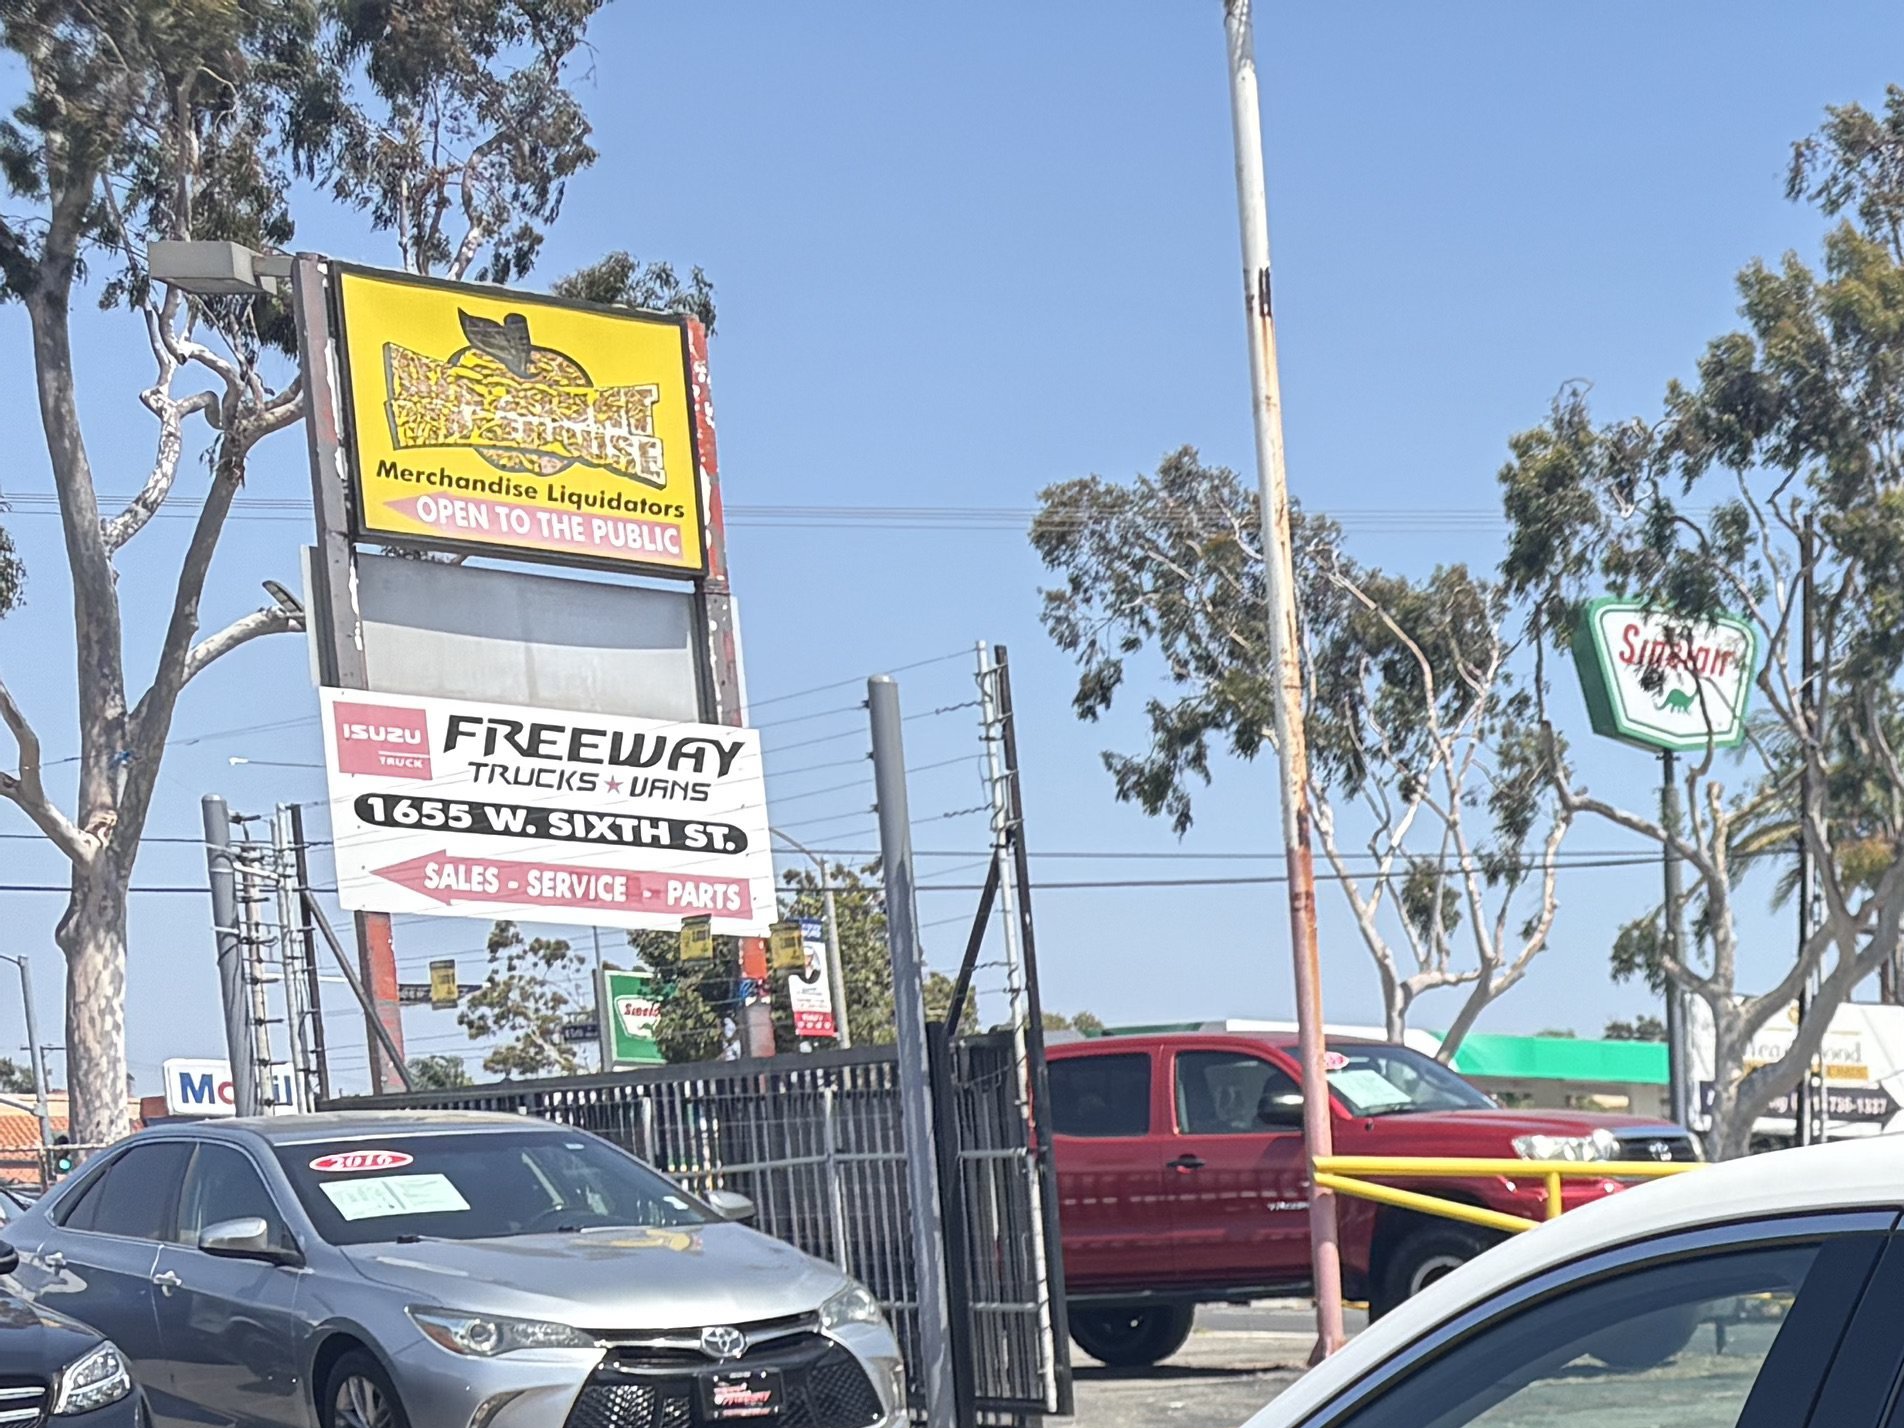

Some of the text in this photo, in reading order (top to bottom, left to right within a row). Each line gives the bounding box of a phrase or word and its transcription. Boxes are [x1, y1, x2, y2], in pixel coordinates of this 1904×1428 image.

[376, 459, 685, 518] Merchandise Liquidators
[416, 495, 680, 554] OPEN TO THE PUBLIC
[343, 722, 422, 745] ISUZU
[443, 714, 747, 779] FREEWAY
[378, 755, 424, 769] TRUCK
[467, 761, 712, 802] TRUCKS VANS
[366, 796, 738, 852] 1655 W. SIXTH ST.
[424, 861, 500, 894] SALES
[527, 868, 627, 902] SERVICE
[666, 879, 742, 912] PARTS
[178, 1070, 294, 1107] Moil
[328, 1153, 393, 1170] 2016
